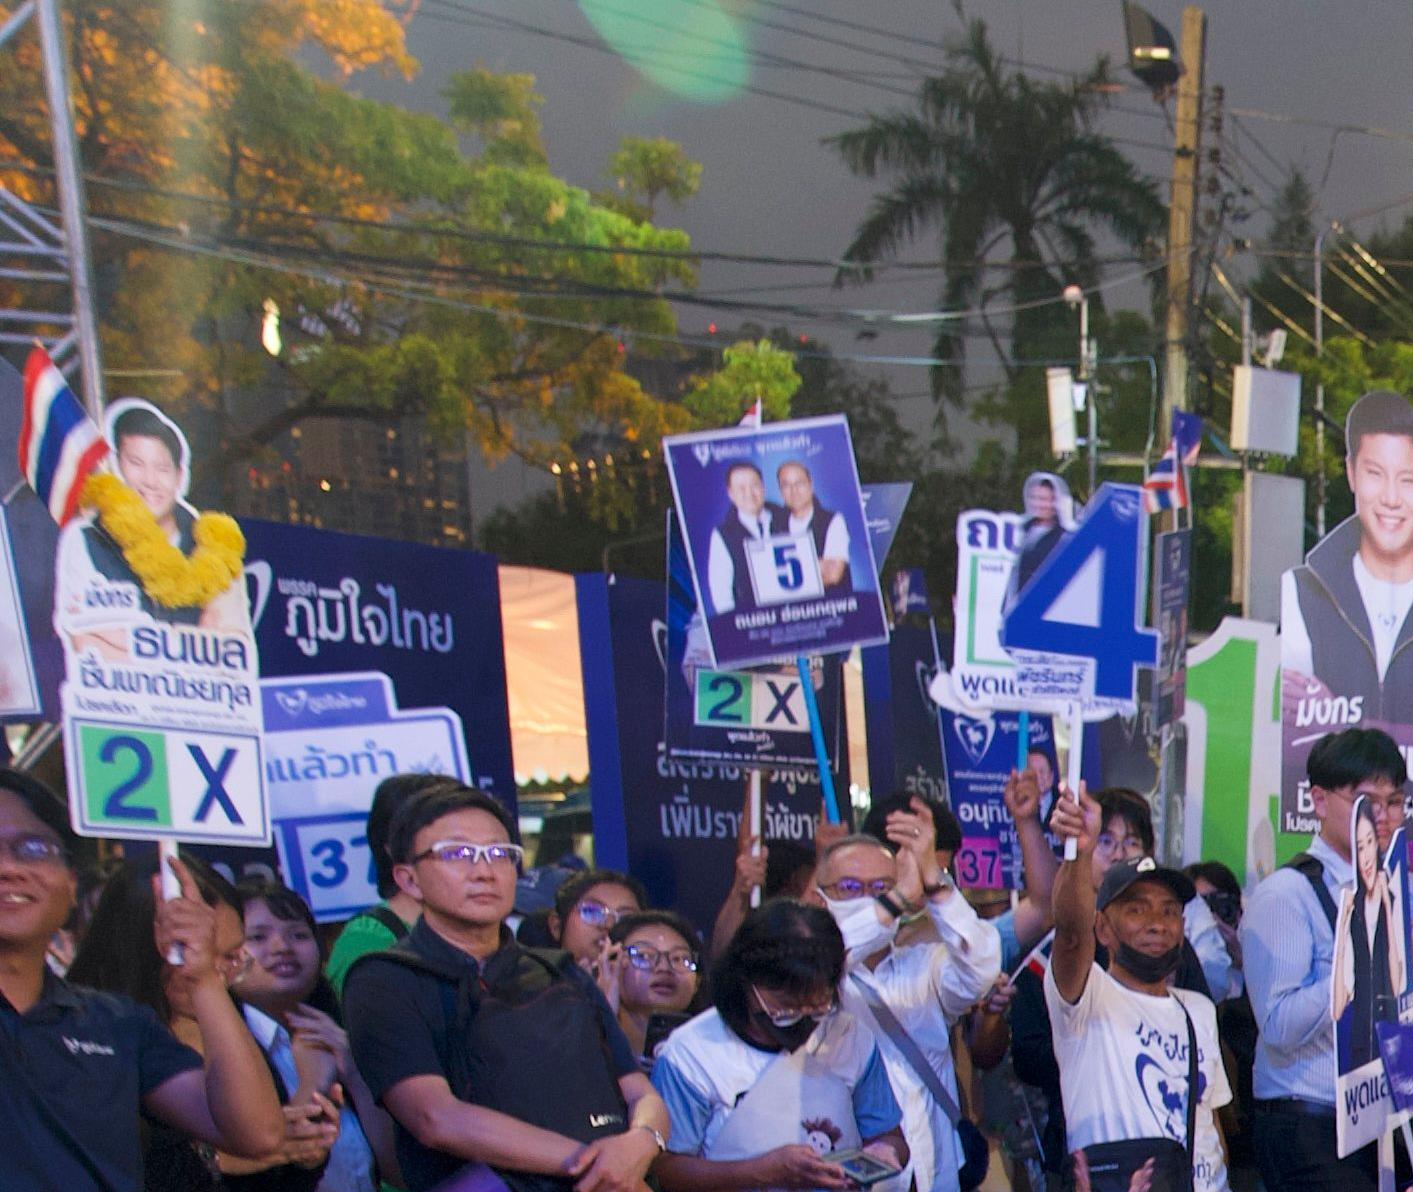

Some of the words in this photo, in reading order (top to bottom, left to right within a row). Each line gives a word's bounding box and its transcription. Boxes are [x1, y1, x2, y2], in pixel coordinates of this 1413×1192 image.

[773, 543, 803, 592] 5
[284, 577, 454, 657] ภูมิใจไทย
[132, 626, 248, 671] ธนพล
[708, 677, 743, 721] 2
[765, 680, 799, 725] X
[1294, 679, 1364, 728] มังกร
[100, 736, 158, 821] 2
[186, 743, 246, 825] X
[961, 849, 998, 884] 37
